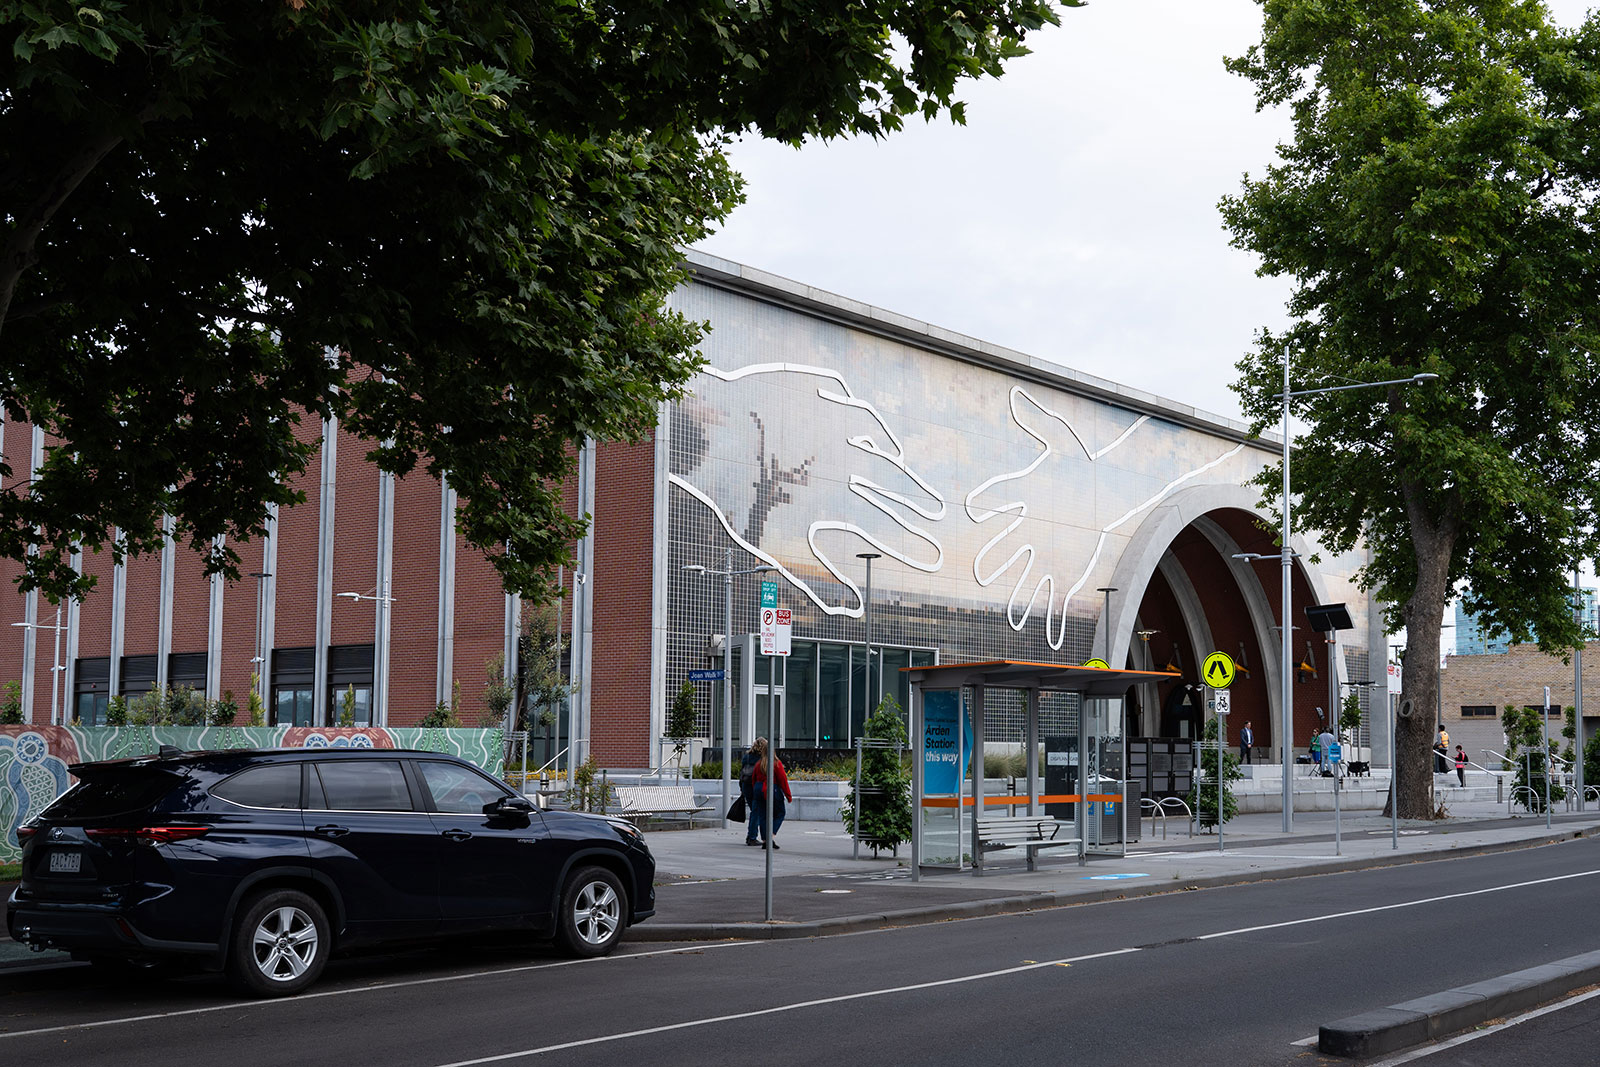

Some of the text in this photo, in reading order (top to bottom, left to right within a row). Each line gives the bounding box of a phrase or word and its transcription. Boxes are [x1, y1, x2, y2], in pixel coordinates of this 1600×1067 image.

[925, 725, 950, 736] Arden
[925, 737, 955, 749] Station
[925, 751, 959, 765] this way
